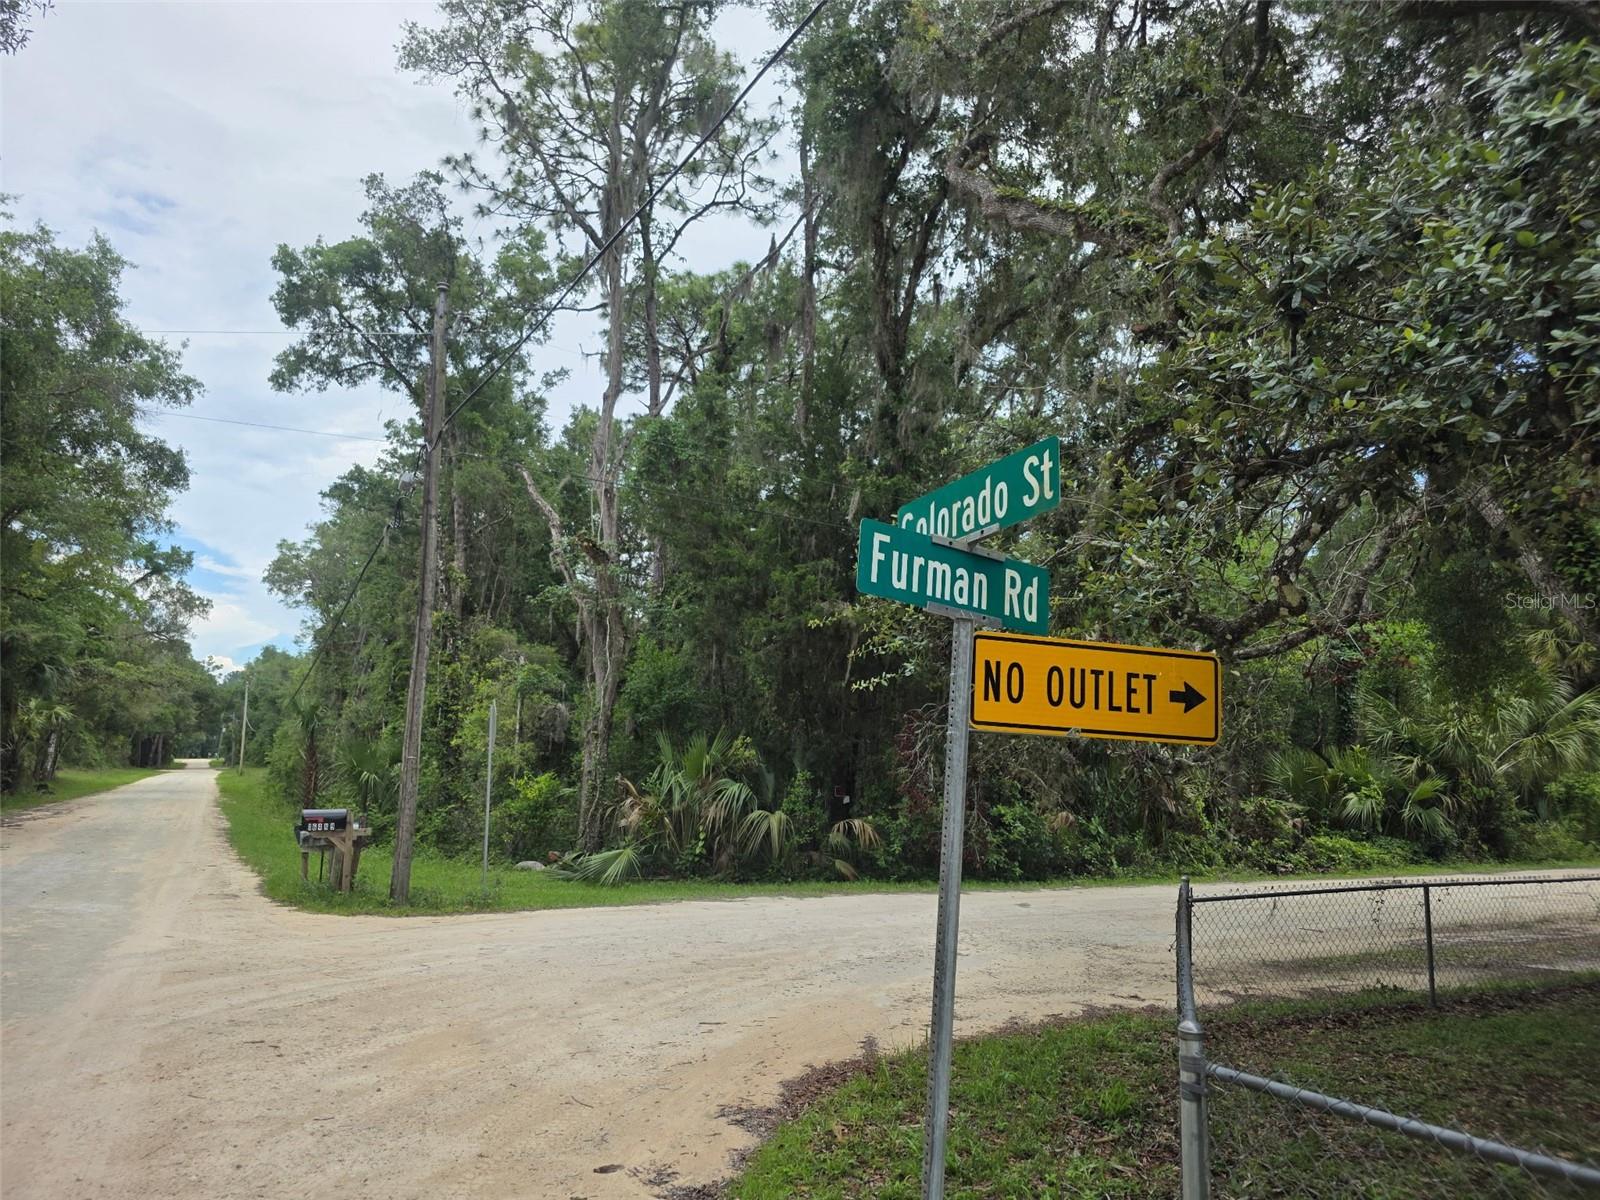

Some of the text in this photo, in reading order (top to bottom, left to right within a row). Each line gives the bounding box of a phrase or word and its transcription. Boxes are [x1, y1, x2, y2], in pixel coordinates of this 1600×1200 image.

[1022, 449, 1054, 508] St
[870, 532, 1039, 623] Furman Rd
[983, 659, 1157, 715] NO OUTLET
